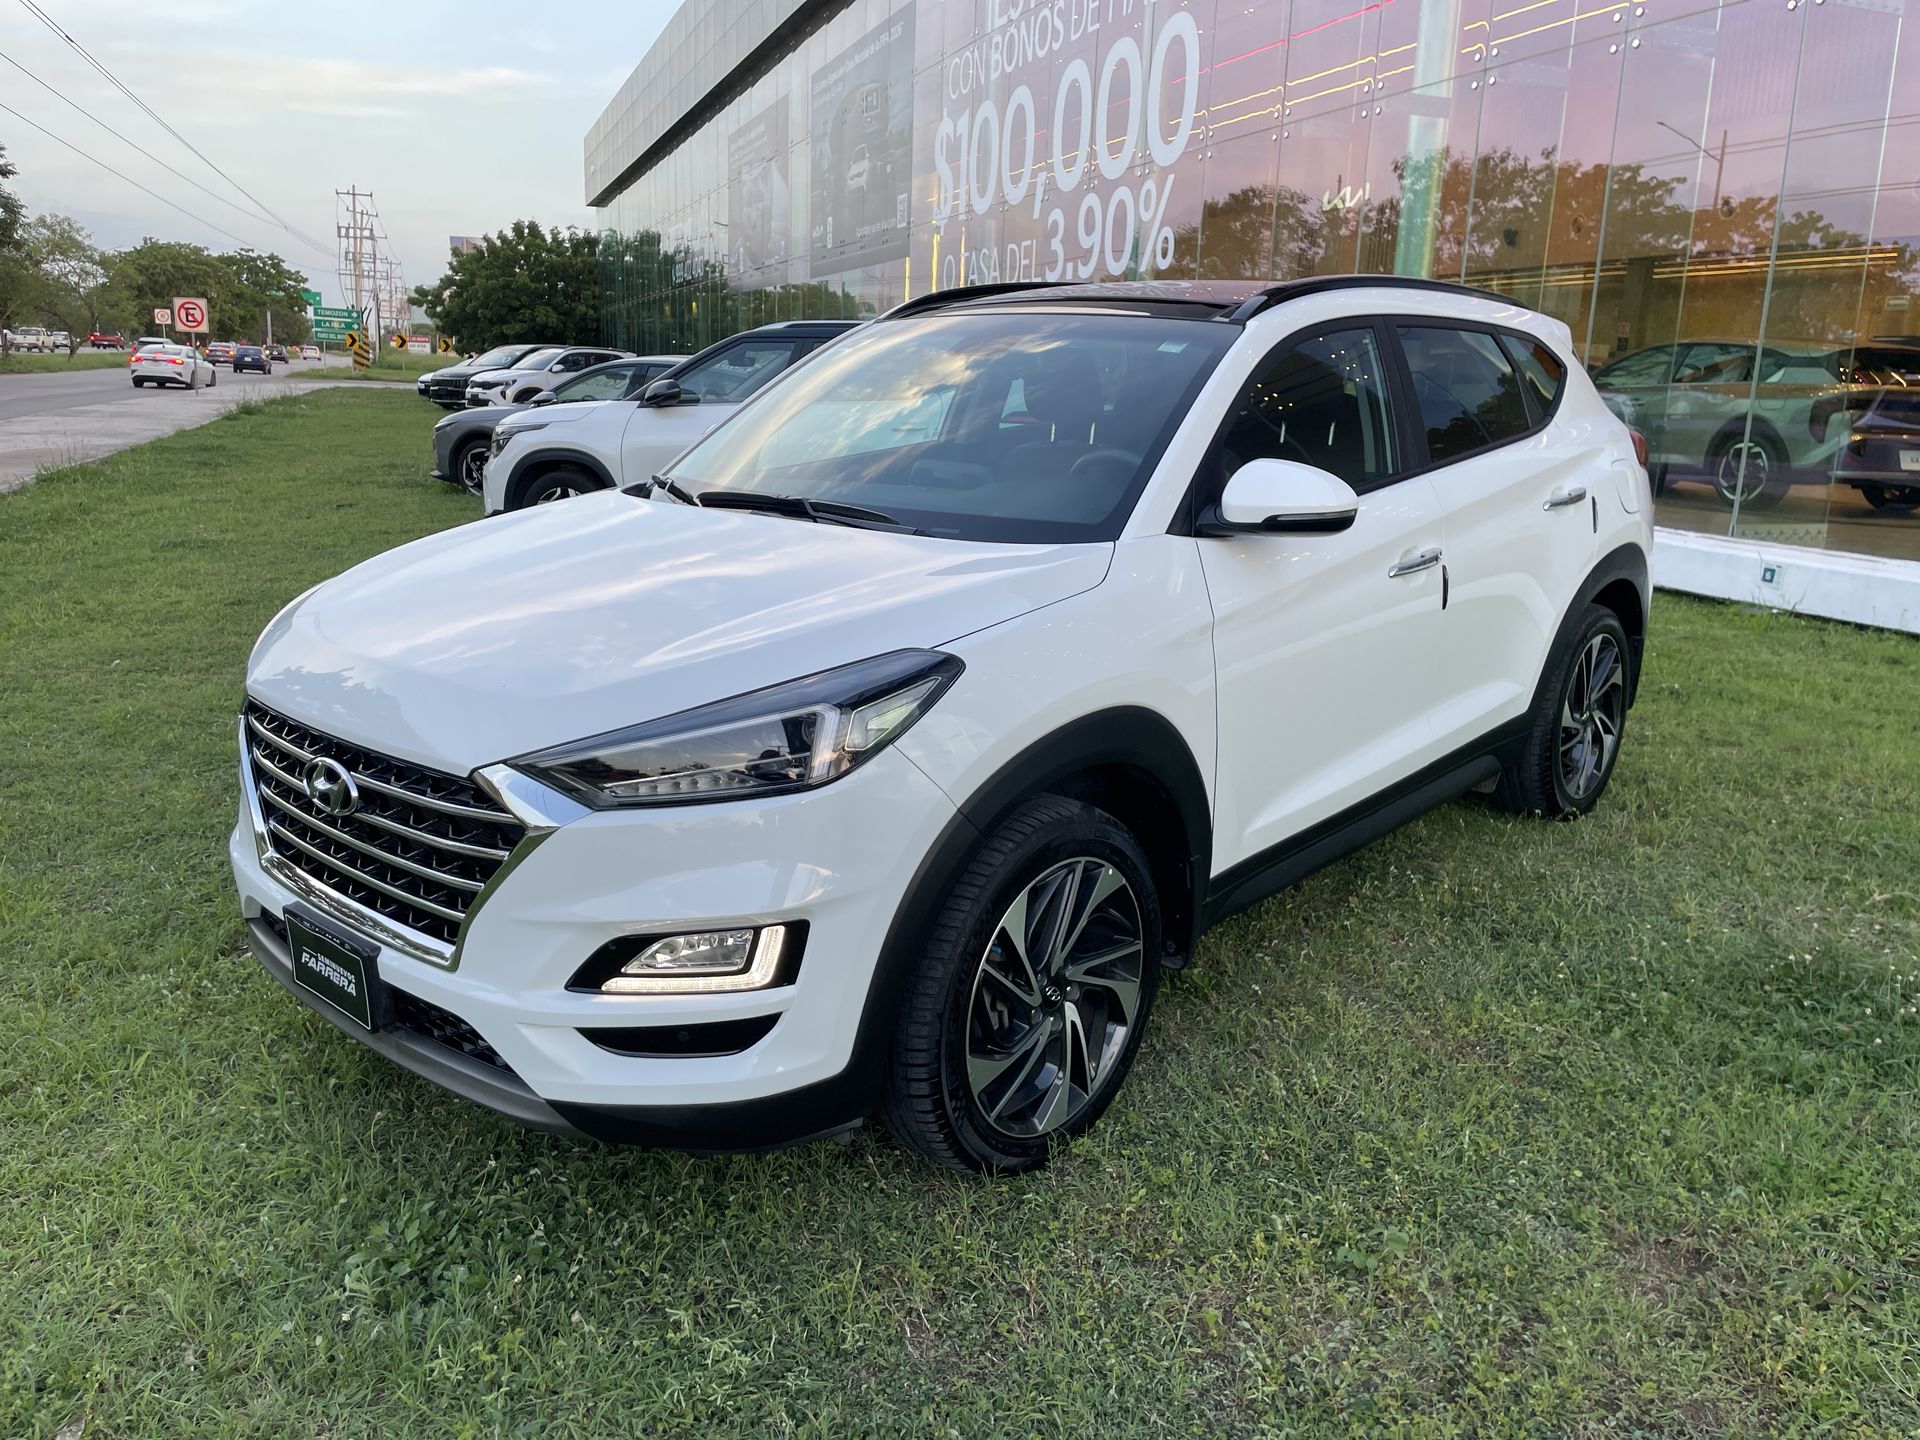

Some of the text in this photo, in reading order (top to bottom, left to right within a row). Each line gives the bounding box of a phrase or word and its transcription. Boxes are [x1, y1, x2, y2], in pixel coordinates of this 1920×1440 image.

[949, 43, 986, 99] CON
[990, 2, 1065, 81] BONOS
[933, 11, 1200, 235] $100,000
[1006, 239, 1042, 283] DEL
[1045, 174, 1175, 282] 3.90%
[301, 952, 356, 997] FARRERA
